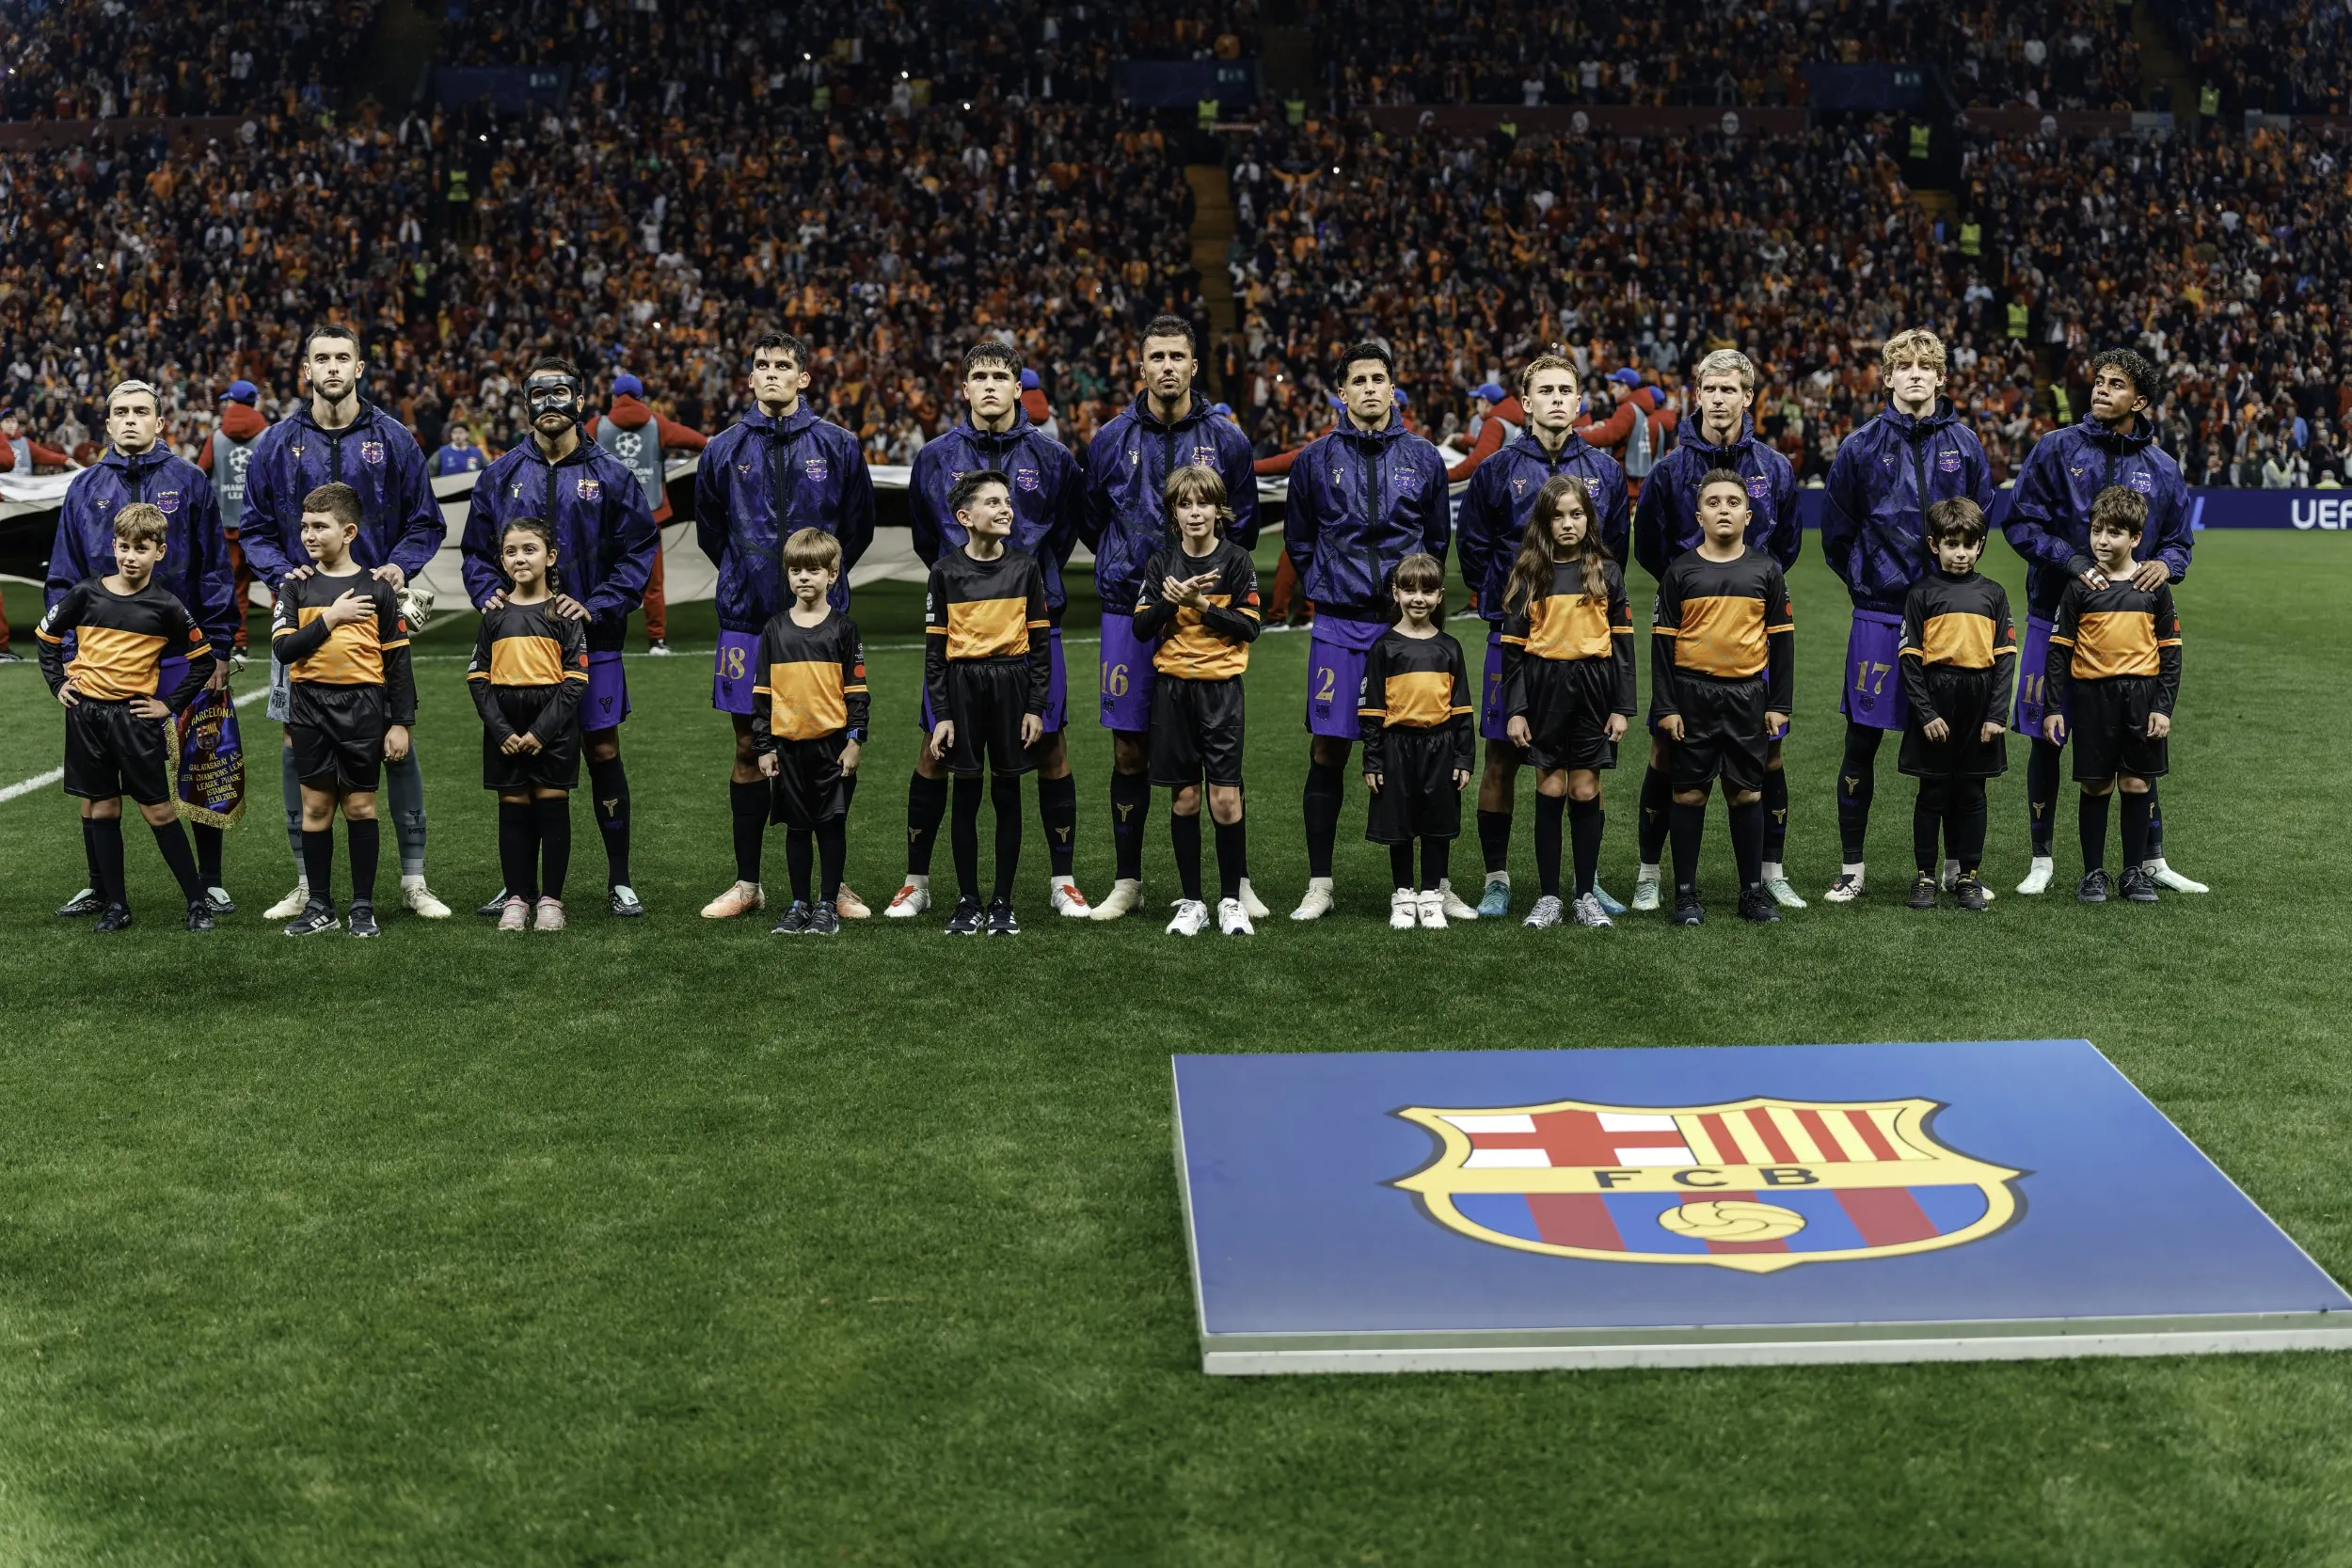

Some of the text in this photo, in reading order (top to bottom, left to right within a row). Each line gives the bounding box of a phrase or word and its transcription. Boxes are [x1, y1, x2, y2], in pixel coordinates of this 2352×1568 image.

[715, 645, 746, 679] 18
[1101, 661, 1129, 696] 16
[1853, 660, 1892, 694] 17
[1314, 666, 1335, 703] 2
[188, 758, 228, 770] GALATASARAY
[196, 768, 228, 782] CHAMPIONS
[197, 773, 241, 791] LEAGUE PHASE
